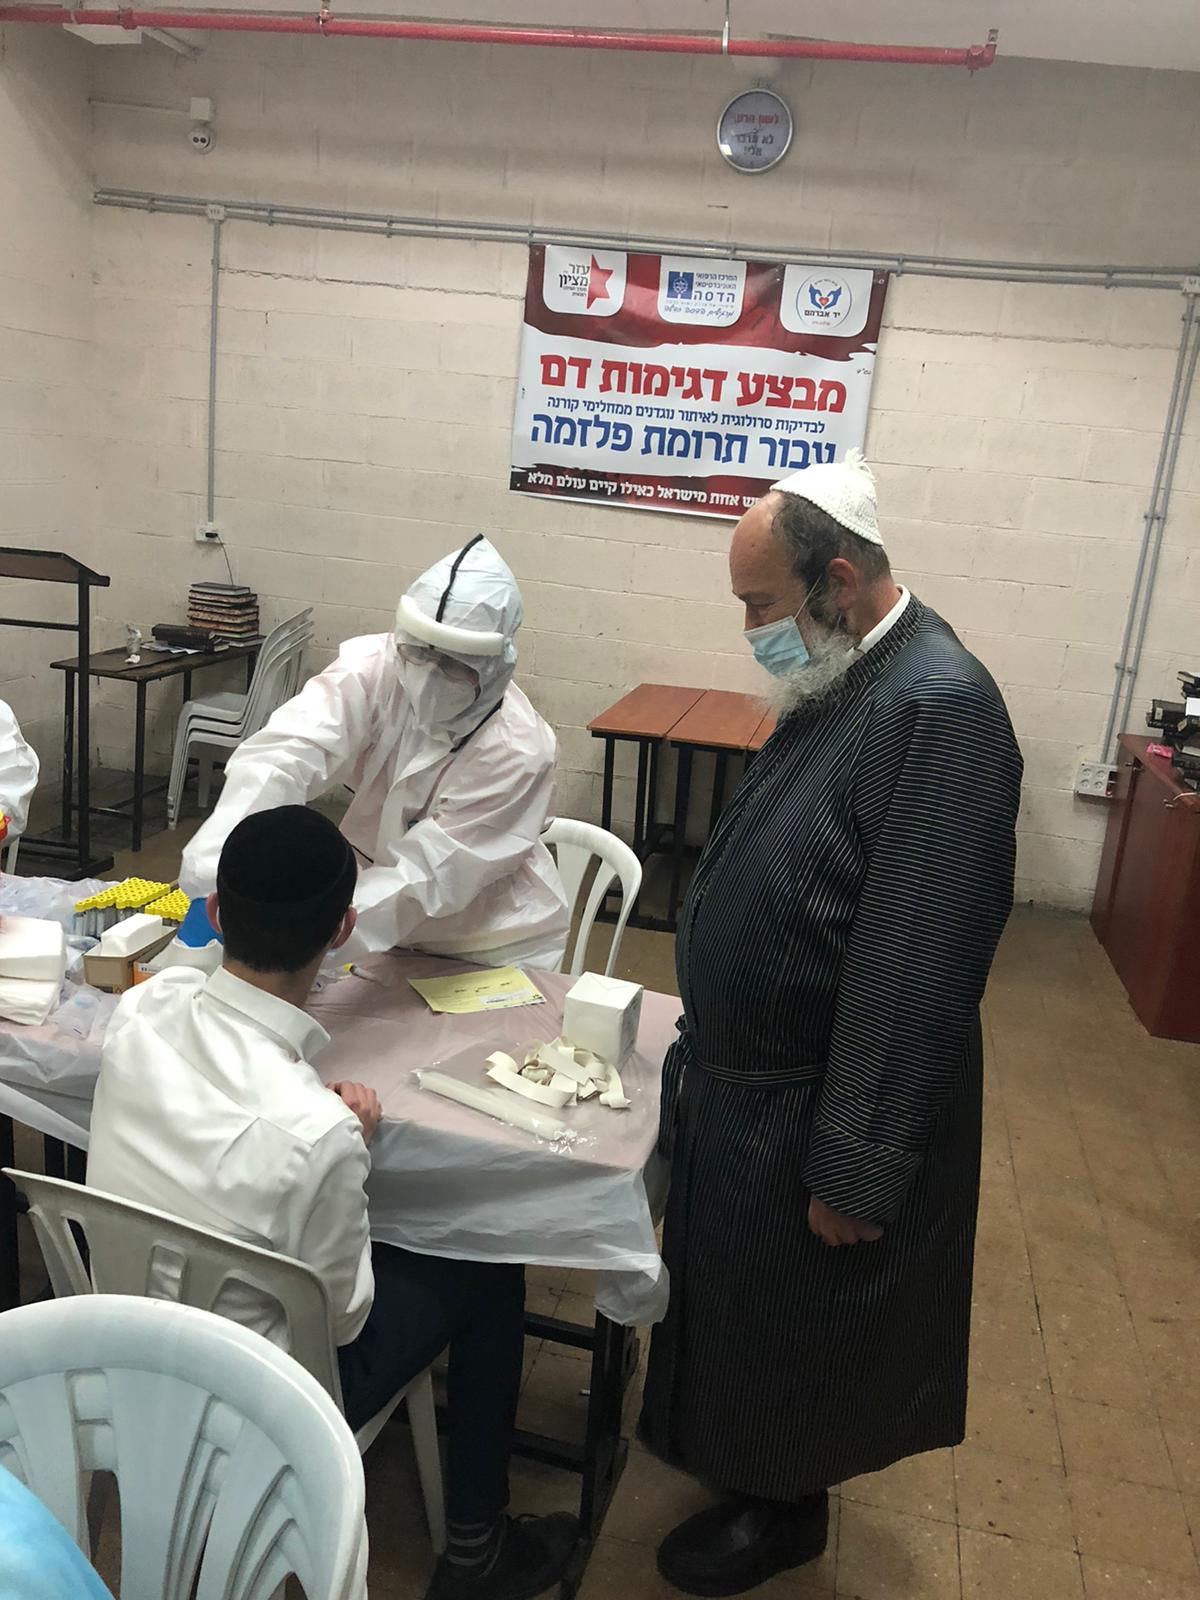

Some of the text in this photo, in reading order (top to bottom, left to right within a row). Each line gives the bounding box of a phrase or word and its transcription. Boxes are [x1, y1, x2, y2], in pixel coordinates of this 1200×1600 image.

[761, 134, 775, 145] לא
[569, 263, 590, 275] עזר
[718, 272, 738, 281] המרכז
[559, 274, 588, 288] מציון
[694, 290, 735, 303] הדסה
[804, 309, 841, 319] יד אברהם
[540, 354, 847, 413] מבצע דגימות דם
[547, 396, 826, 434] לבדיקות סרולוגית לאיתור נוגדנים ממחלימי קורנה
[531, 413, 837, 470] עבור תרומת פלזמה
[527, 471, 553, 487] מלא
[556, 474, 586, 490] עולם
[589, 478, 618, 497] קיים
[620, 480, 655, 499] כאילו
[657, 484, 708, 504] מישראל
[709, 492, 740, 507] אחת
